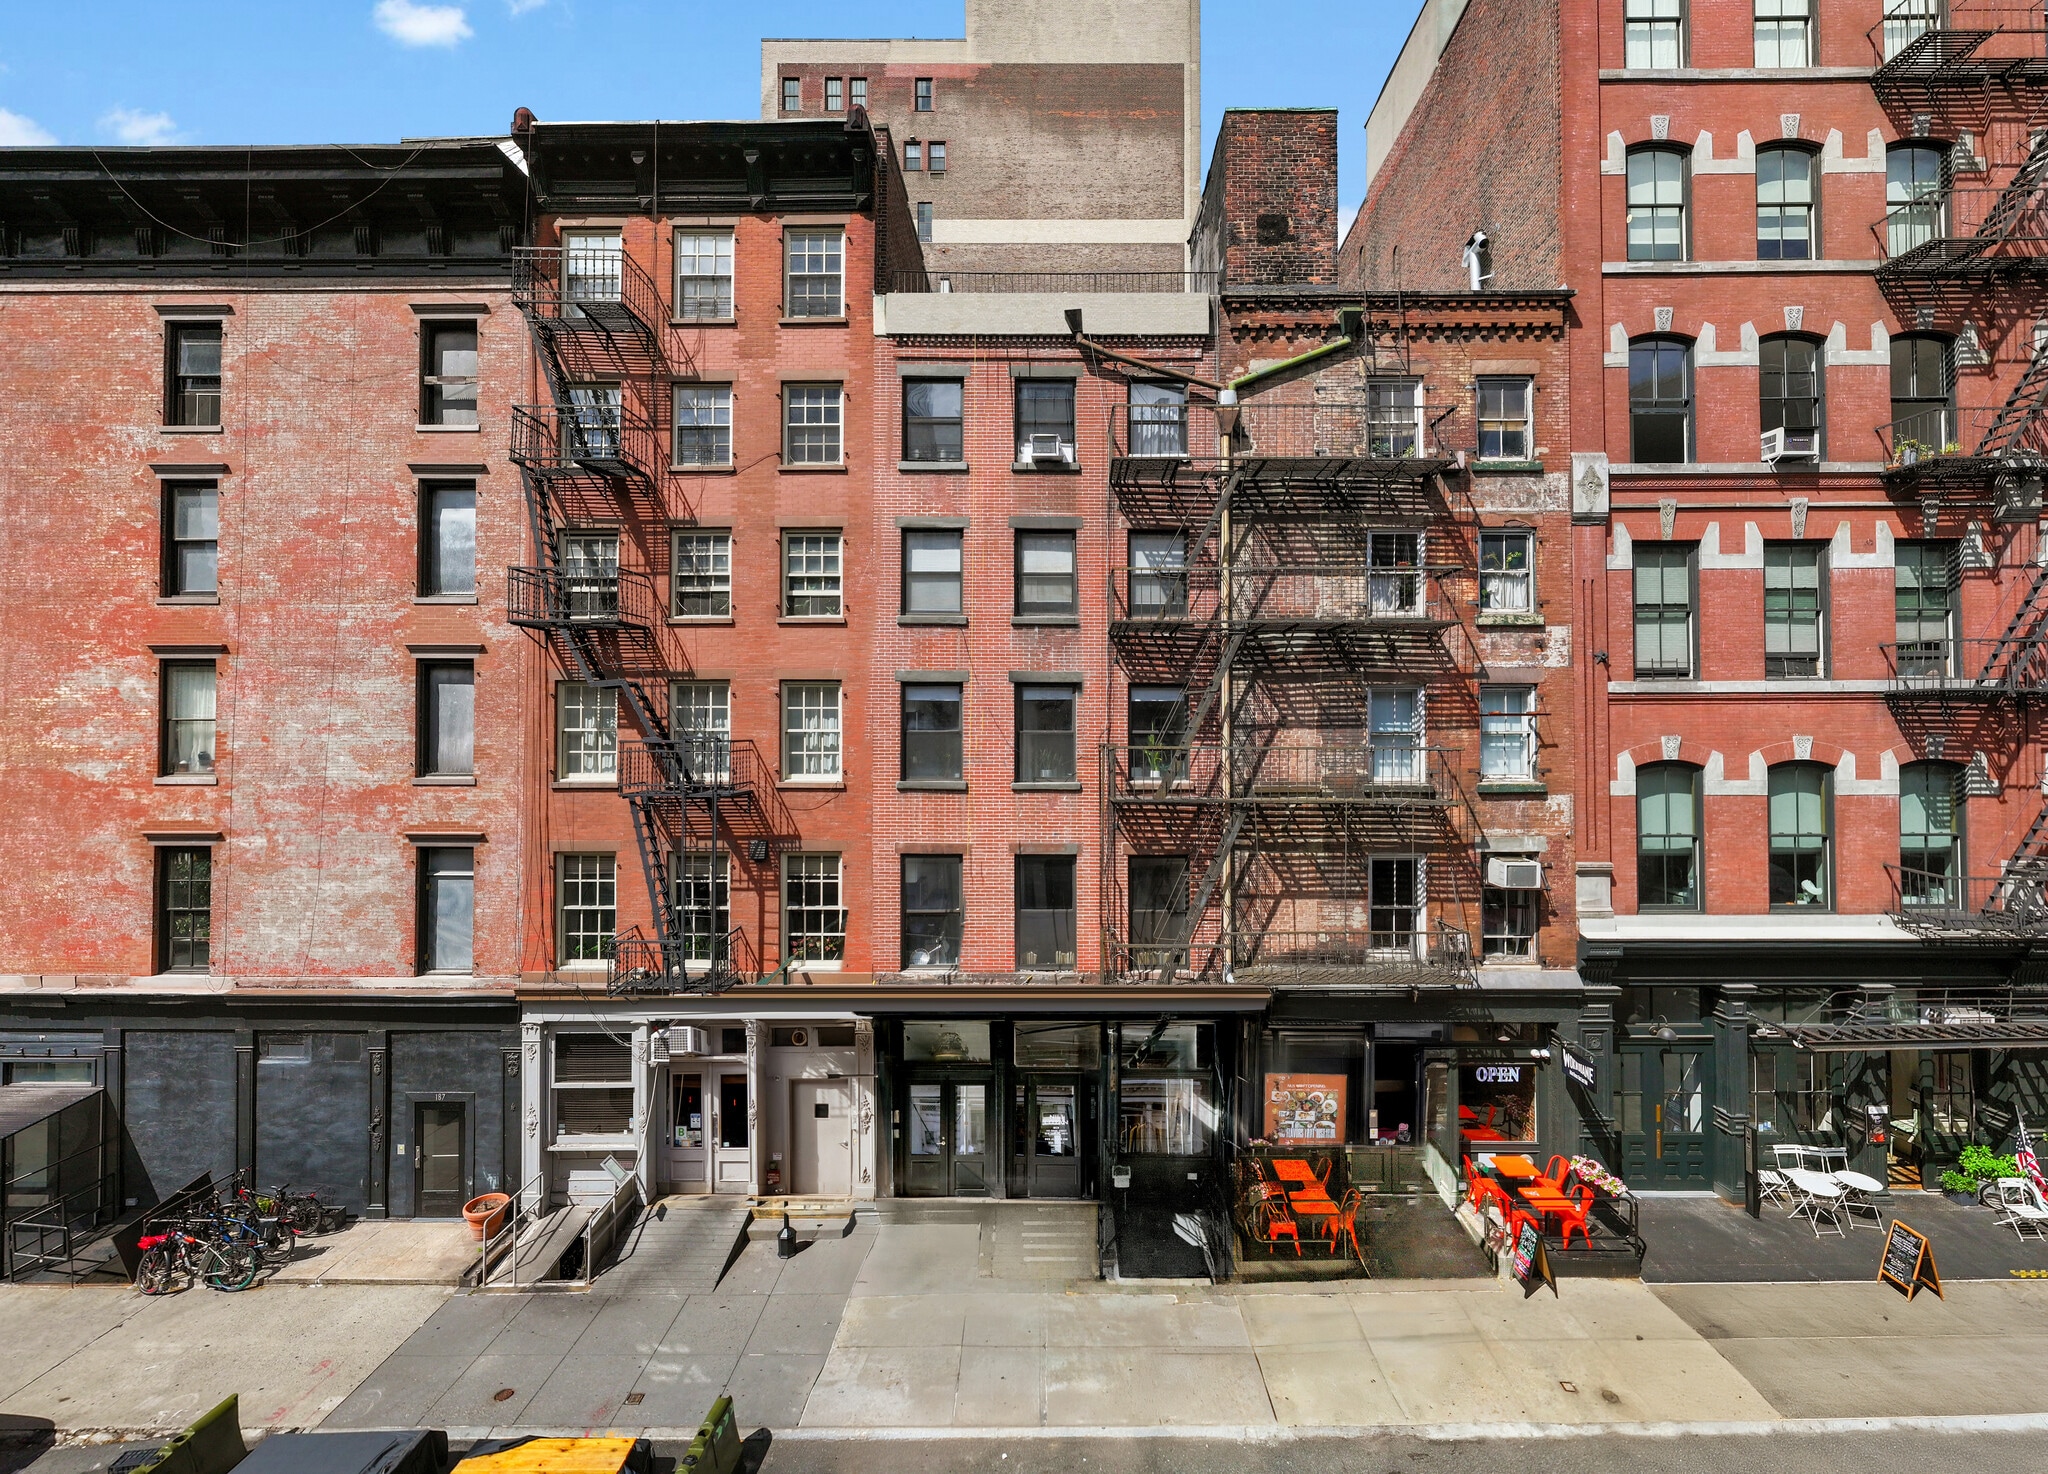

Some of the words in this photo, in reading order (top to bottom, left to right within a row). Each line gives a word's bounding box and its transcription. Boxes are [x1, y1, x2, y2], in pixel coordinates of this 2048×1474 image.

[1475, 1066, 1520, 1082] OPEN
[435, 1093, 446, 1101] 187
[678, 1127, 685, 1136] B
